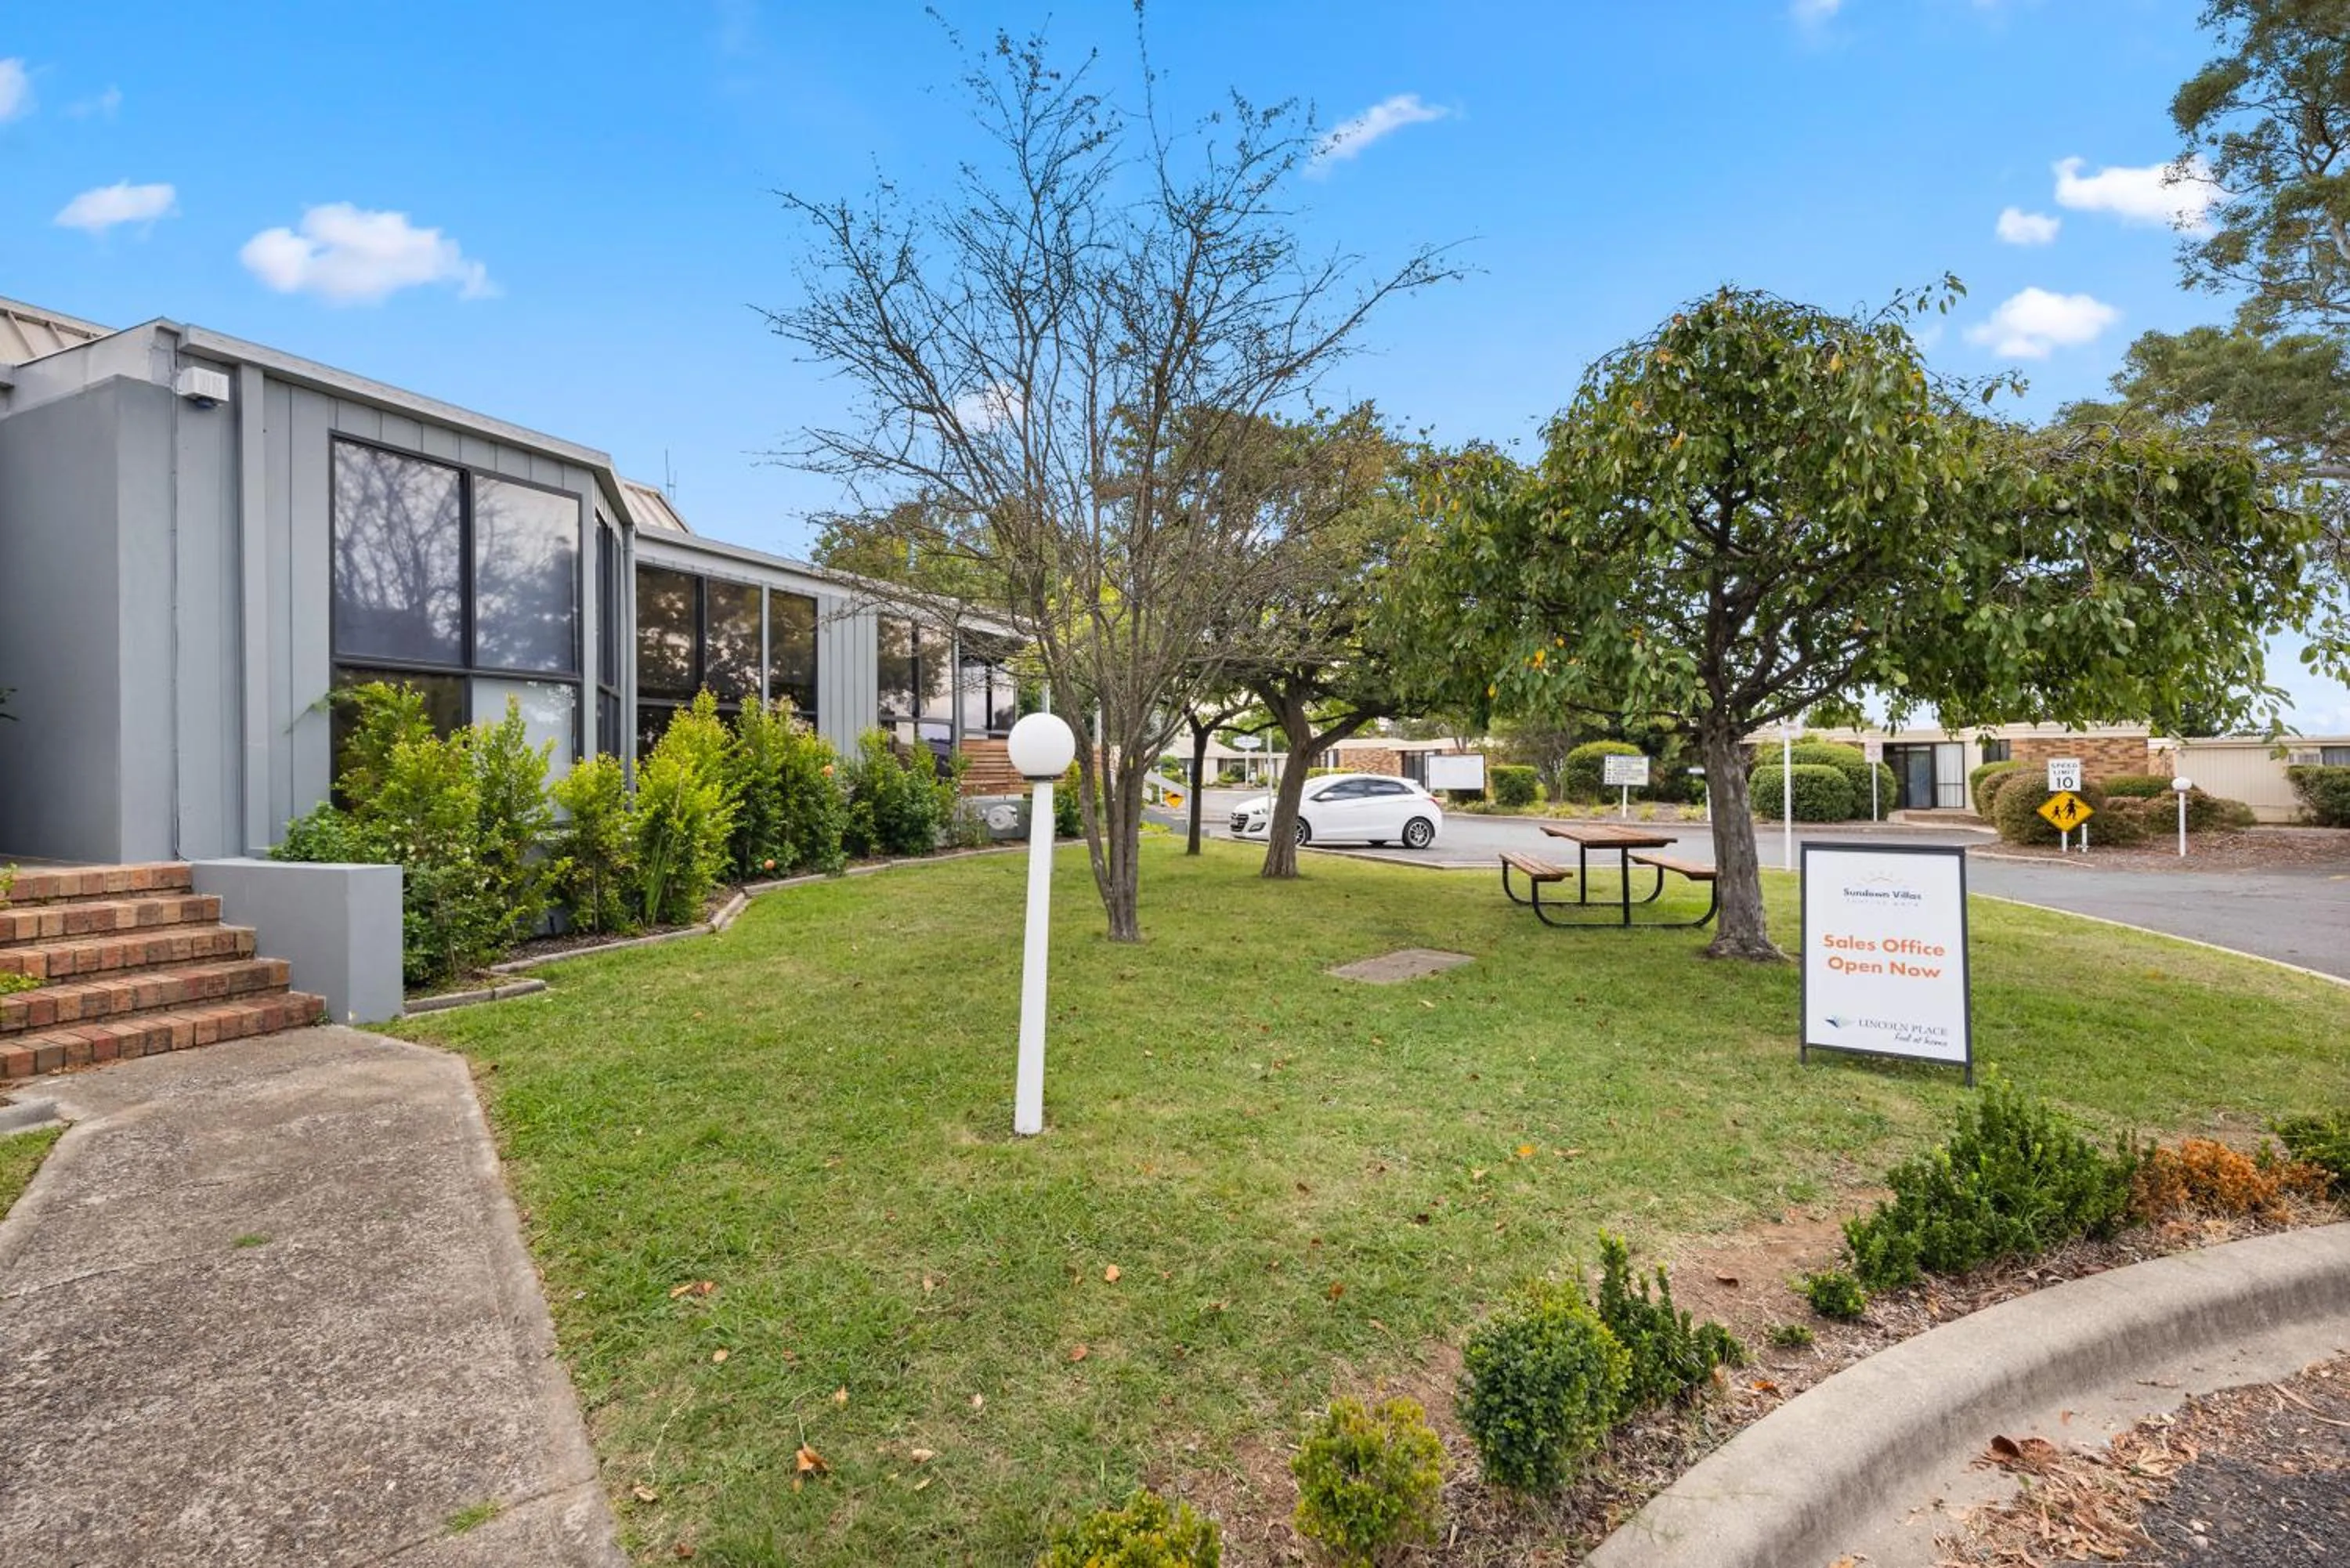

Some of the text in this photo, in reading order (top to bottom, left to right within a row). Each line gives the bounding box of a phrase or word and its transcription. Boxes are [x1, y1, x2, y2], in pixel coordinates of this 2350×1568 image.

[2056, 777, 2073, 789] 10
[1892, 891, 1922, 900] Villas
[1824, 934, 1945, 956] Sales Office
[1828, 956, 1941, 977] Open Now
[1859, 1019, 1948, 1035] LINCOLN PLACE
